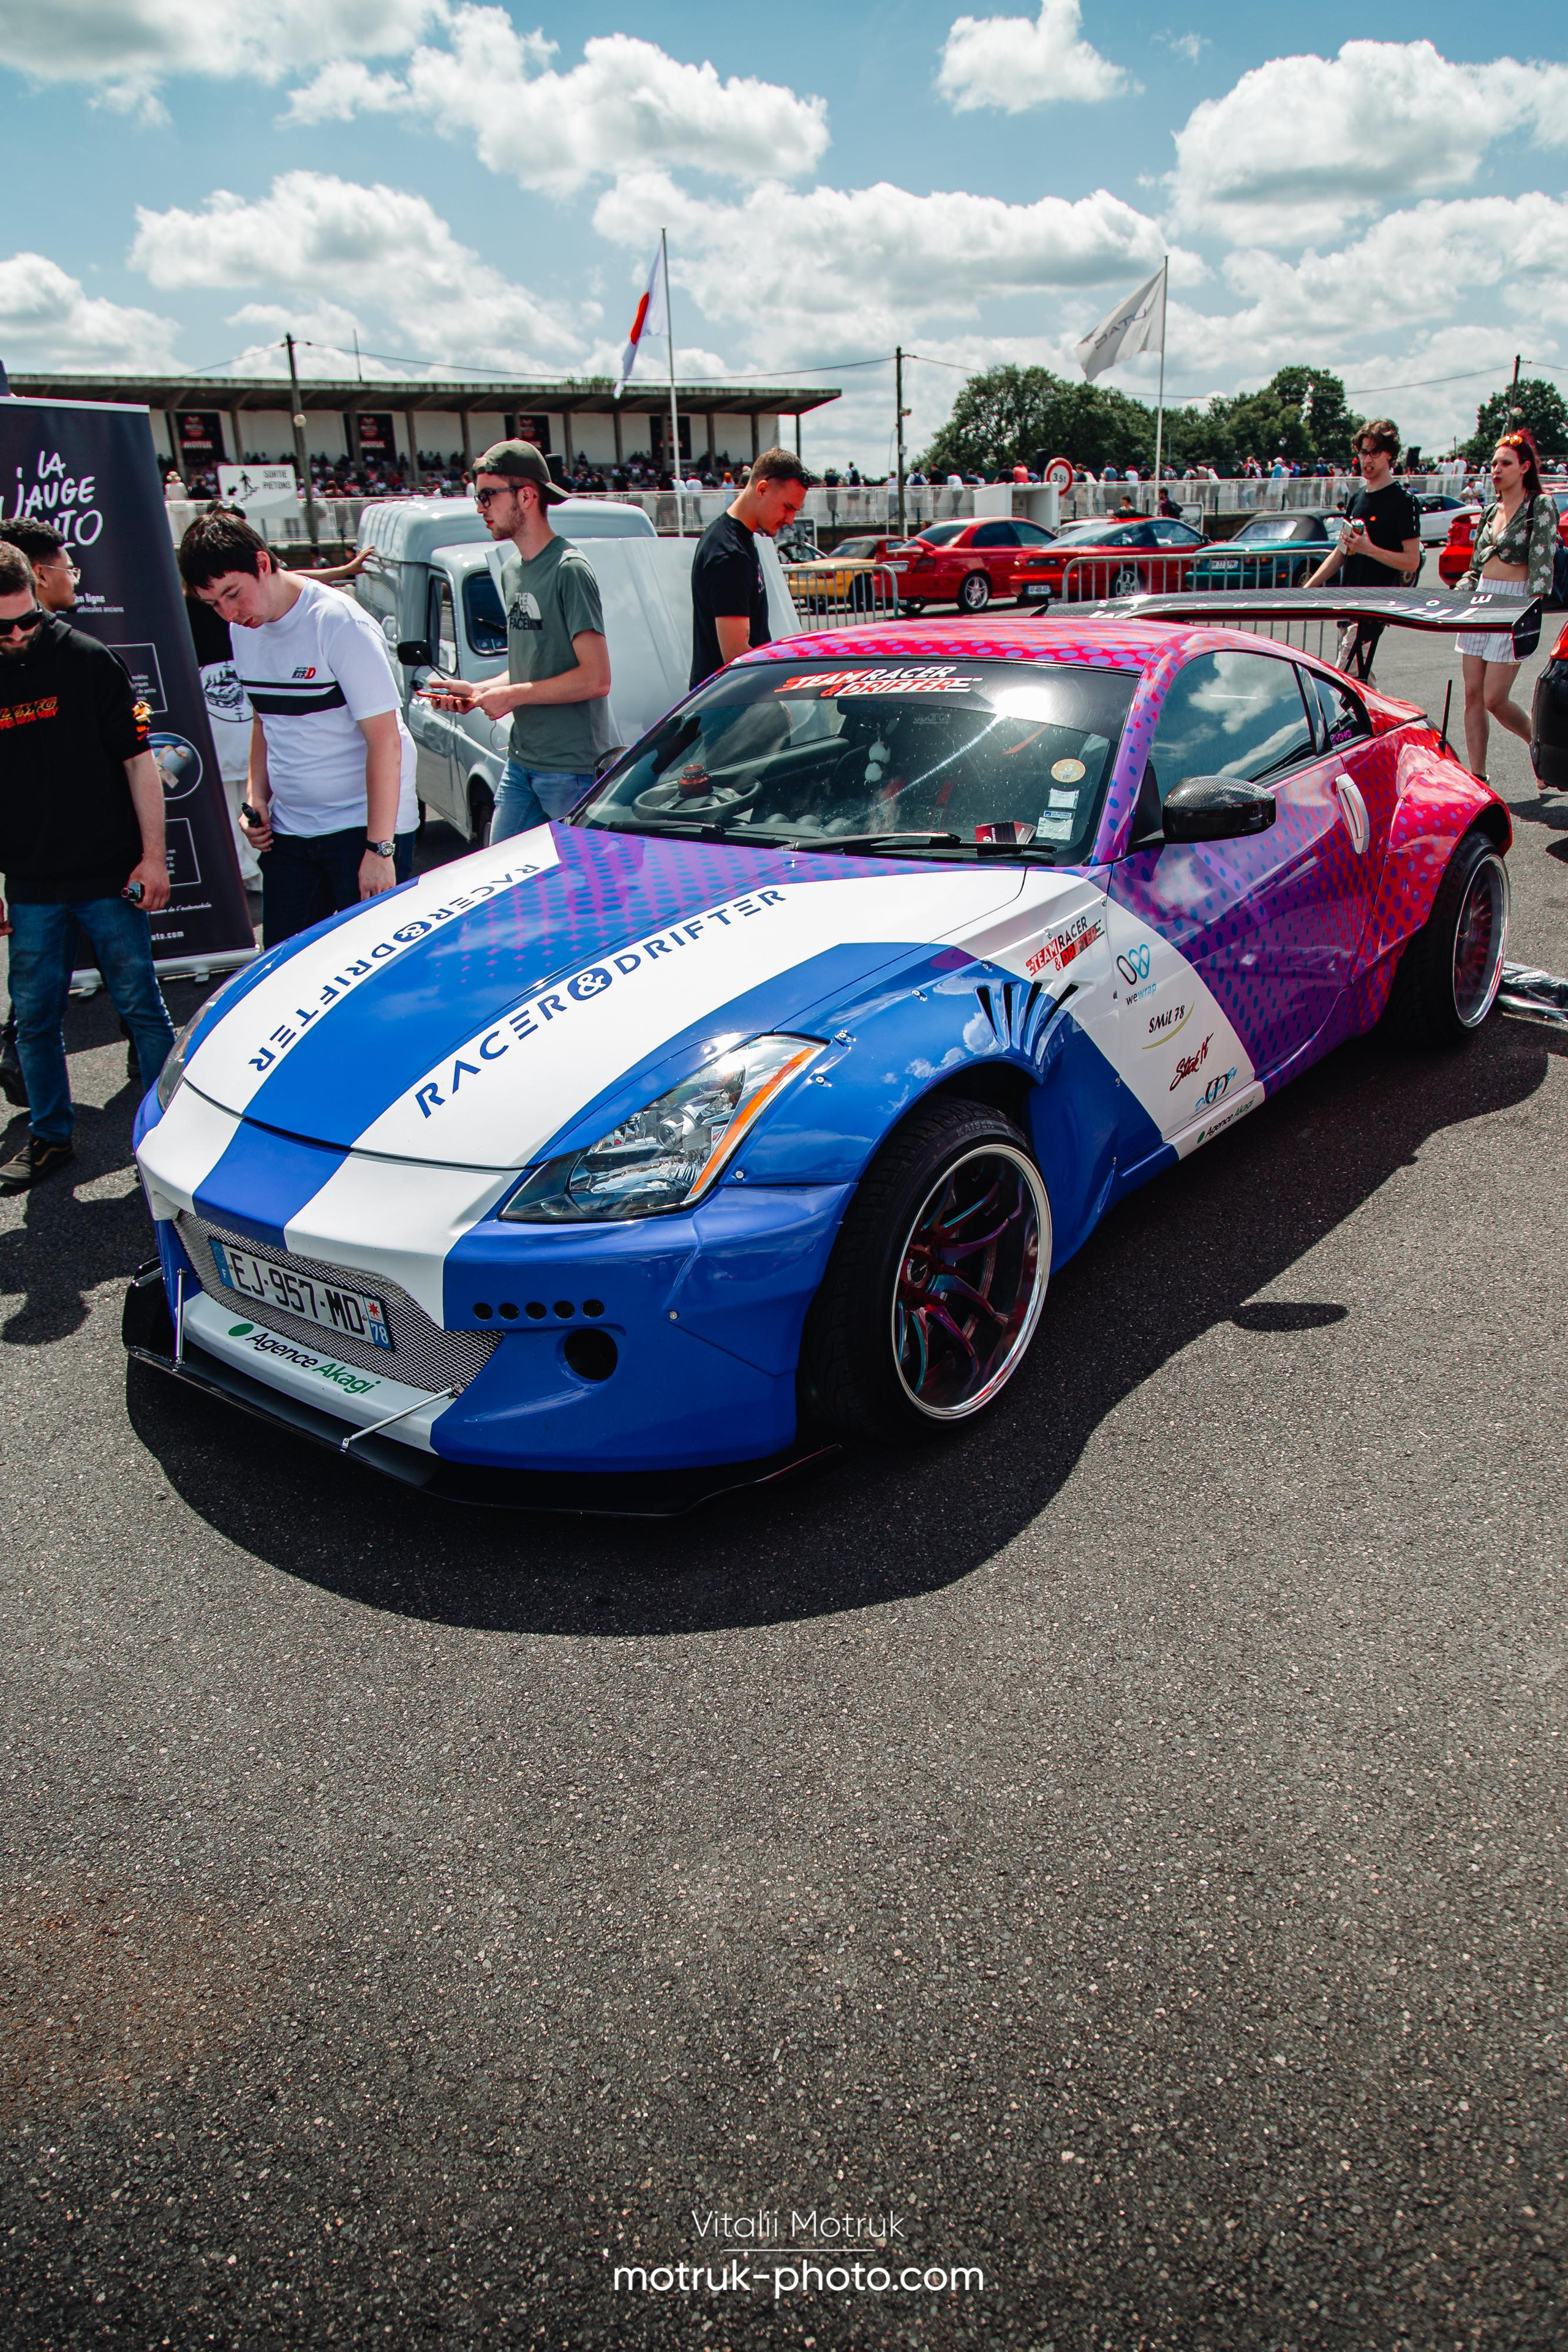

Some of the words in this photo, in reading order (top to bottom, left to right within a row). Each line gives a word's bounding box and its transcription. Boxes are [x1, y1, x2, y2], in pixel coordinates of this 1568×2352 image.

[37, 450, 67, 479] LA
[263, 469, 288, 478] SORTIE
[1053, 473, 1067, 483] 35t
[85, 592, 105, 604] ligne
[791, 669, 865, 690] TEAM
[859, 666, 957, 681] RACER
[820, 684, 842, 697] &
[841, 679, 957, 695] DRIFTER
[428, 864, 541, 921] RACER
[1057, 916, 1088, 950] RACER
[1054, 957, 1062, 971] &
[1060, 925, 1098, 968] DRIFTER
[415, 993, 567, 1118] RACER
[612, 890, 787, 974] DRIFTER
[1126, 983, 1156, 1006] wewrap
[248, 943, 398, 1072] DRIFTER
[1174, 1005, 1185, 1022] 78
[956, 1121, 995, 1137] KAISER
[221, 1268, 227, 1280] F
[371, 1322, 388, 1344] 78
[245, 1331, 319, 1369] Agence
[313, 1362, 382, 1395] Akagi
